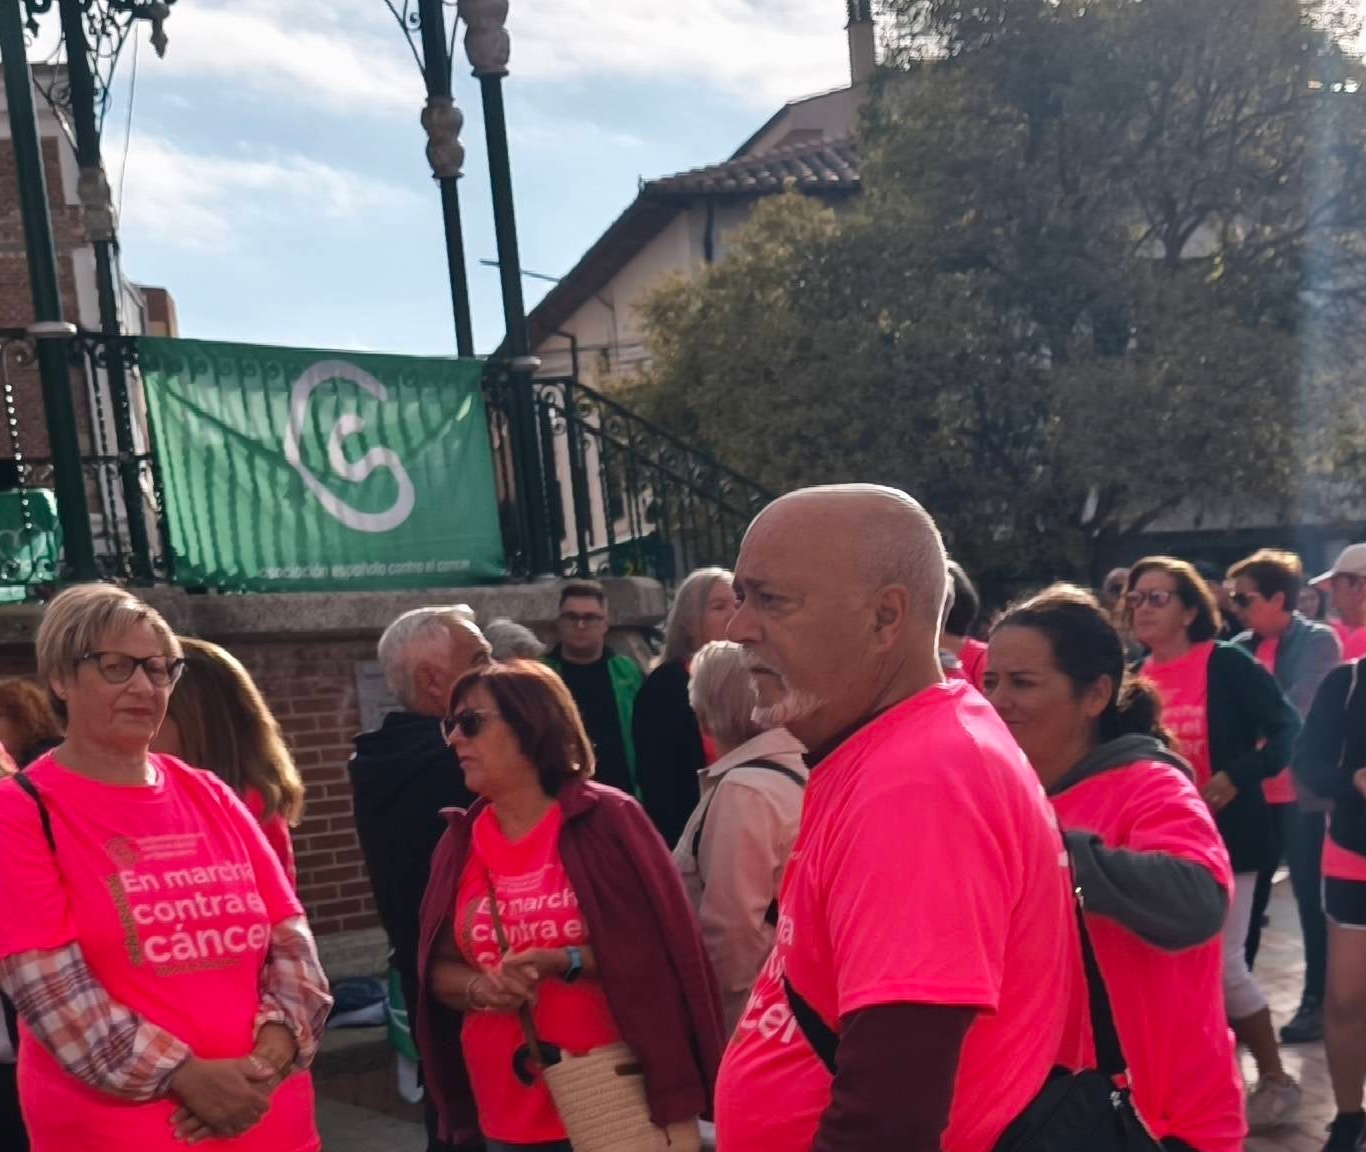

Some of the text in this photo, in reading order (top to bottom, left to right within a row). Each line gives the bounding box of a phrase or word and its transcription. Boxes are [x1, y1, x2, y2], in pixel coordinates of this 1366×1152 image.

[120, 870, 160, 892] En
[132, 892, 245, 925] contra
[143, 924, 271, 963] cánce
